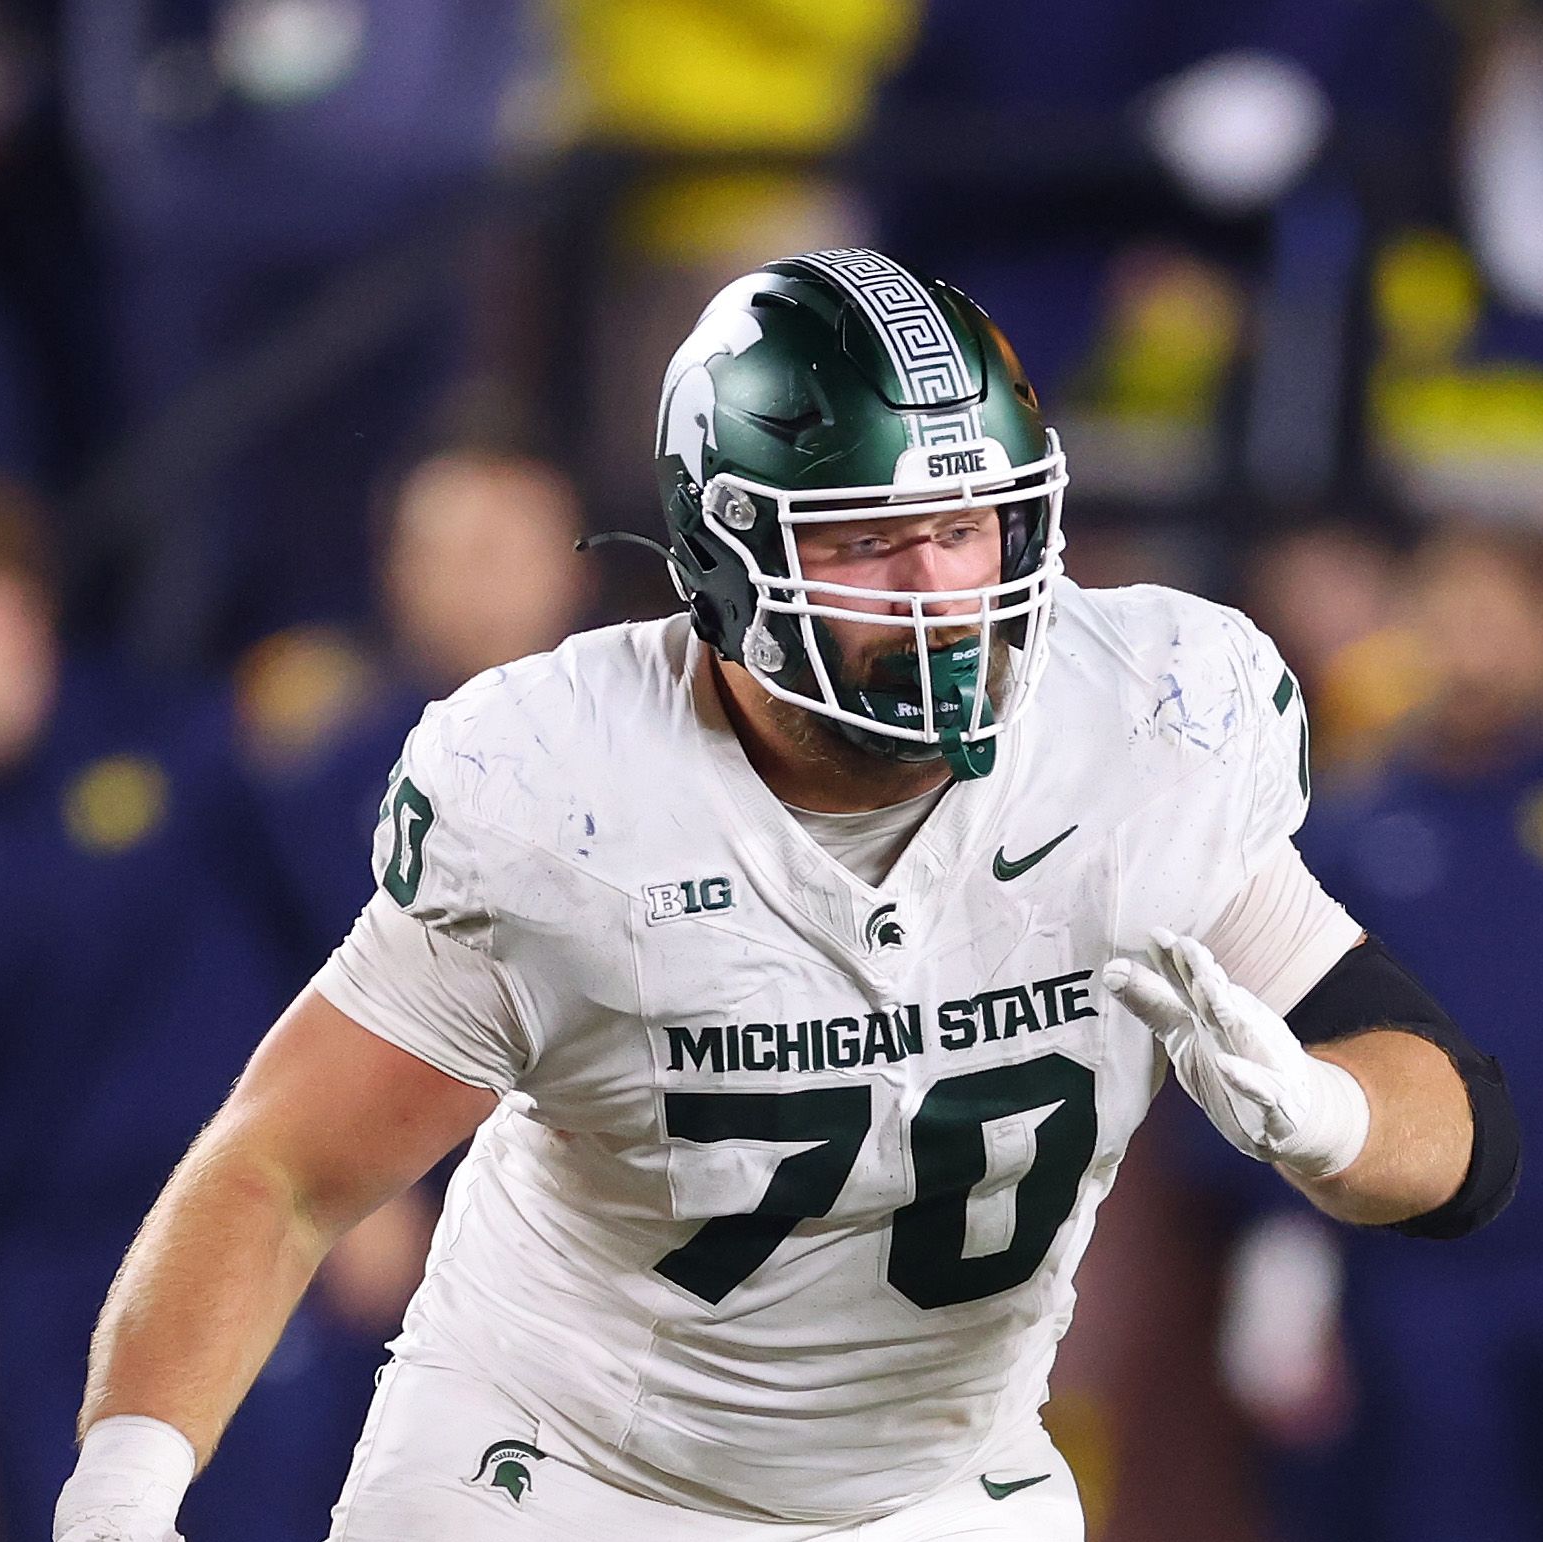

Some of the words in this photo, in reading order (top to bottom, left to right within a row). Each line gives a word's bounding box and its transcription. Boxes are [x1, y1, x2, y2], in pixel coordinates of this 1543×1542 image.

[928, 448, 987, 478] STATE
[663, 1004, 924, 1074] MICHIGAN
[938, 970, 1099, 1051] STATE
[653, 1052, 1098, 1310] 70
